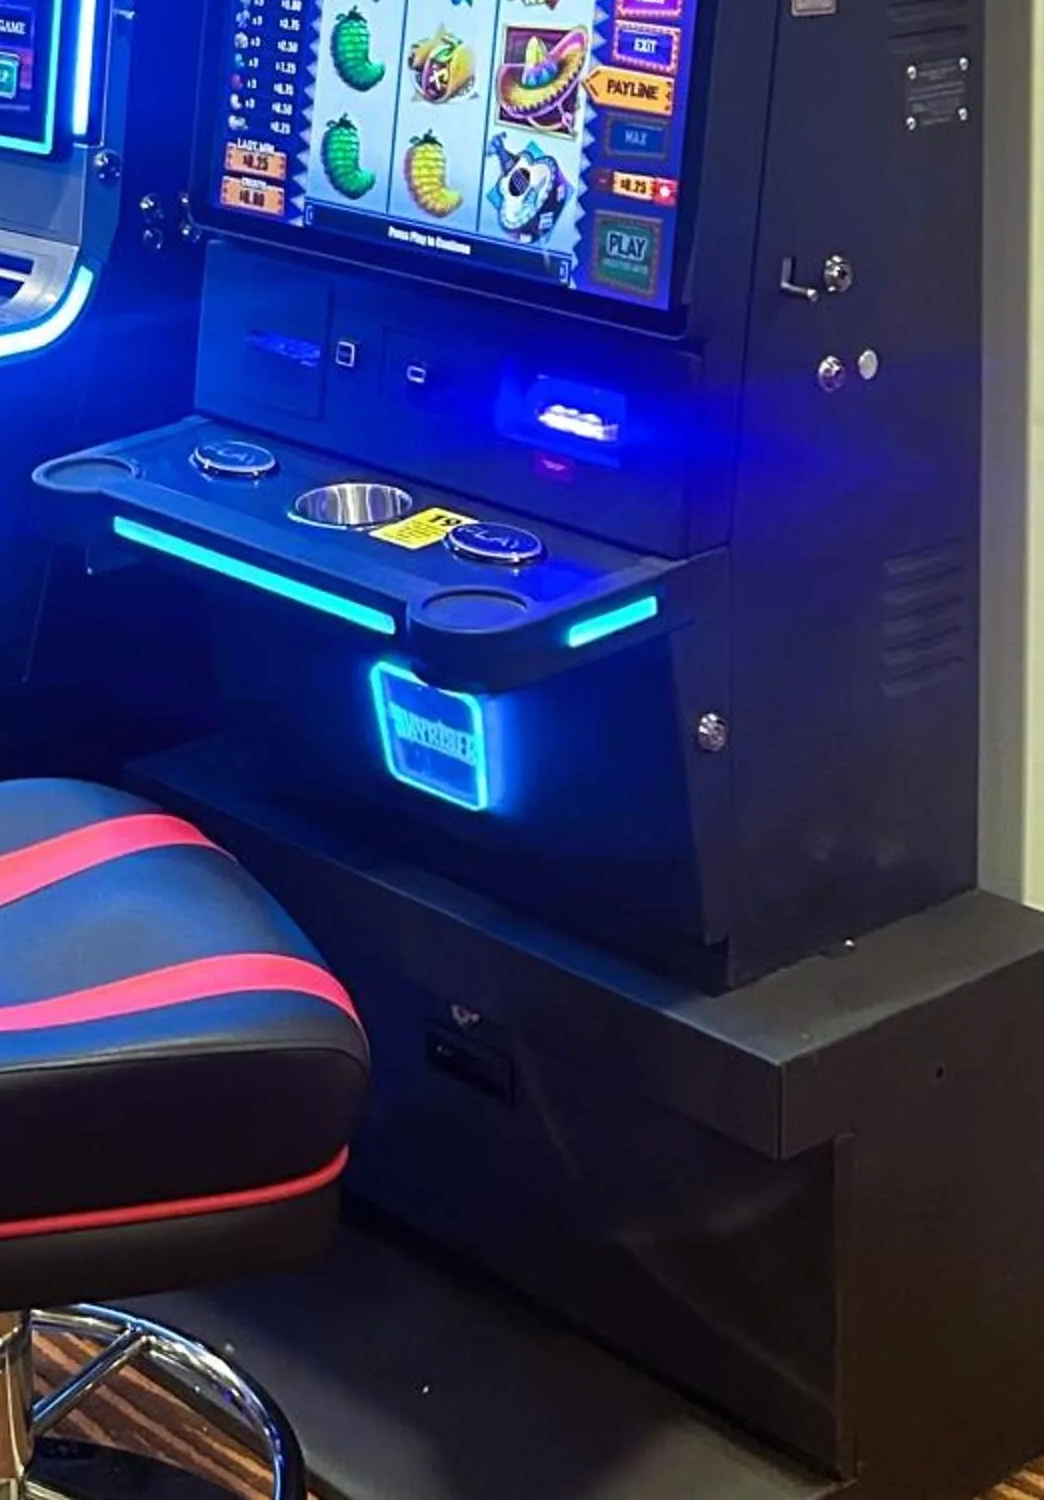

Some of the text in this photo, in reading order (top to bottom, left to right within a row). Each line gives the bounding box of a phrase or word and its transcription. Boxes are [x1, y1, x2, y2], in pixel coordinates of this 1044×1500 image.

[633, 37, 657, 54] EXIT
[606, 79, 660, 101] PAYLINE
[624, 129, 648, 146] MAX
[607, 230, 648, 261] PLAY
